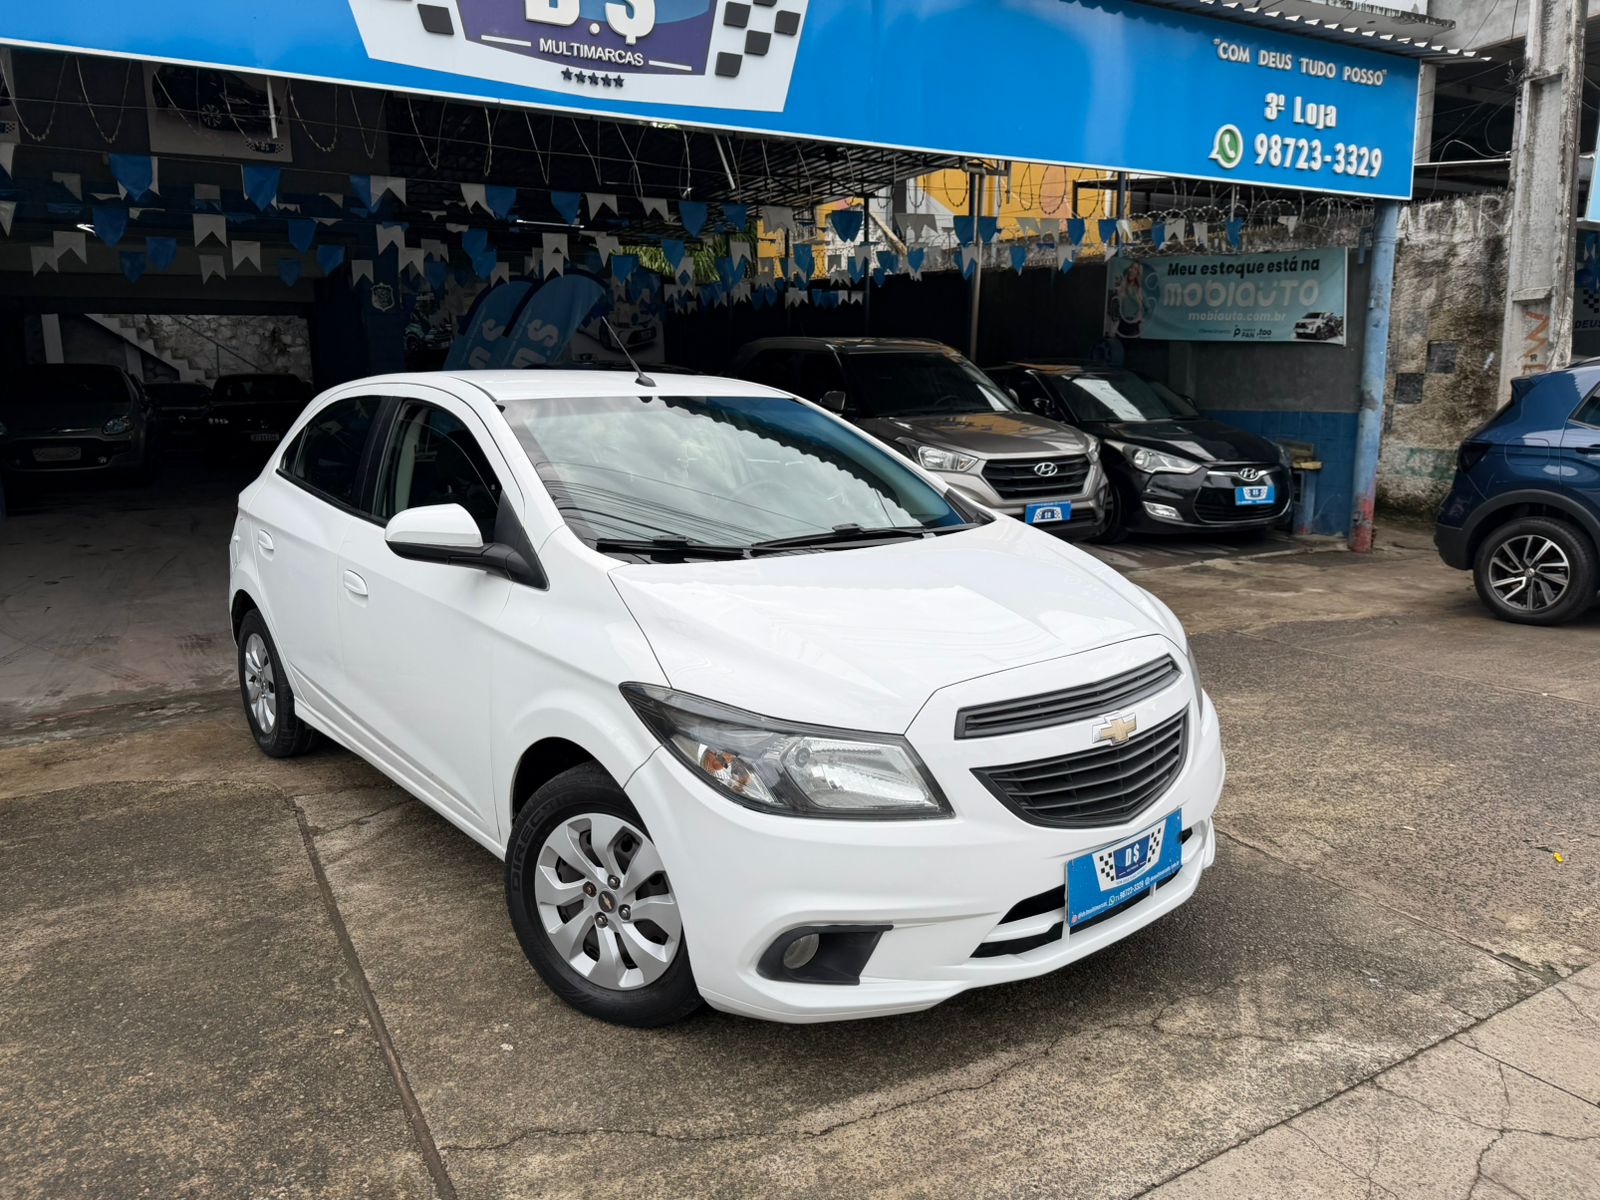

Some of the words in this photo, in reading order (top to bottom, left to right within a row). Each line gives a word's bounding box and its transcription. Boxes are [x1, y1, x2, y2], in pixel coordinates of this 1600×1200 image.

[539, 38, 644, 66] MULTIMARCAS
[1258, 49, 1292, 70] DEUS
[1299, 57, 1336, 78] TUDO
[1293, 96, 1337, 129] Loja
[1254, 133, 1382, 178] 98723-3329
[1168, 263, 1197, 276] Meu
[1200, 261, 1264, 279] estoque
[1267, 256, 1297, 273] está
[1301, 258, 1321, 272] na
[1188, 310, 1287, 321] mobiauto.com.br
